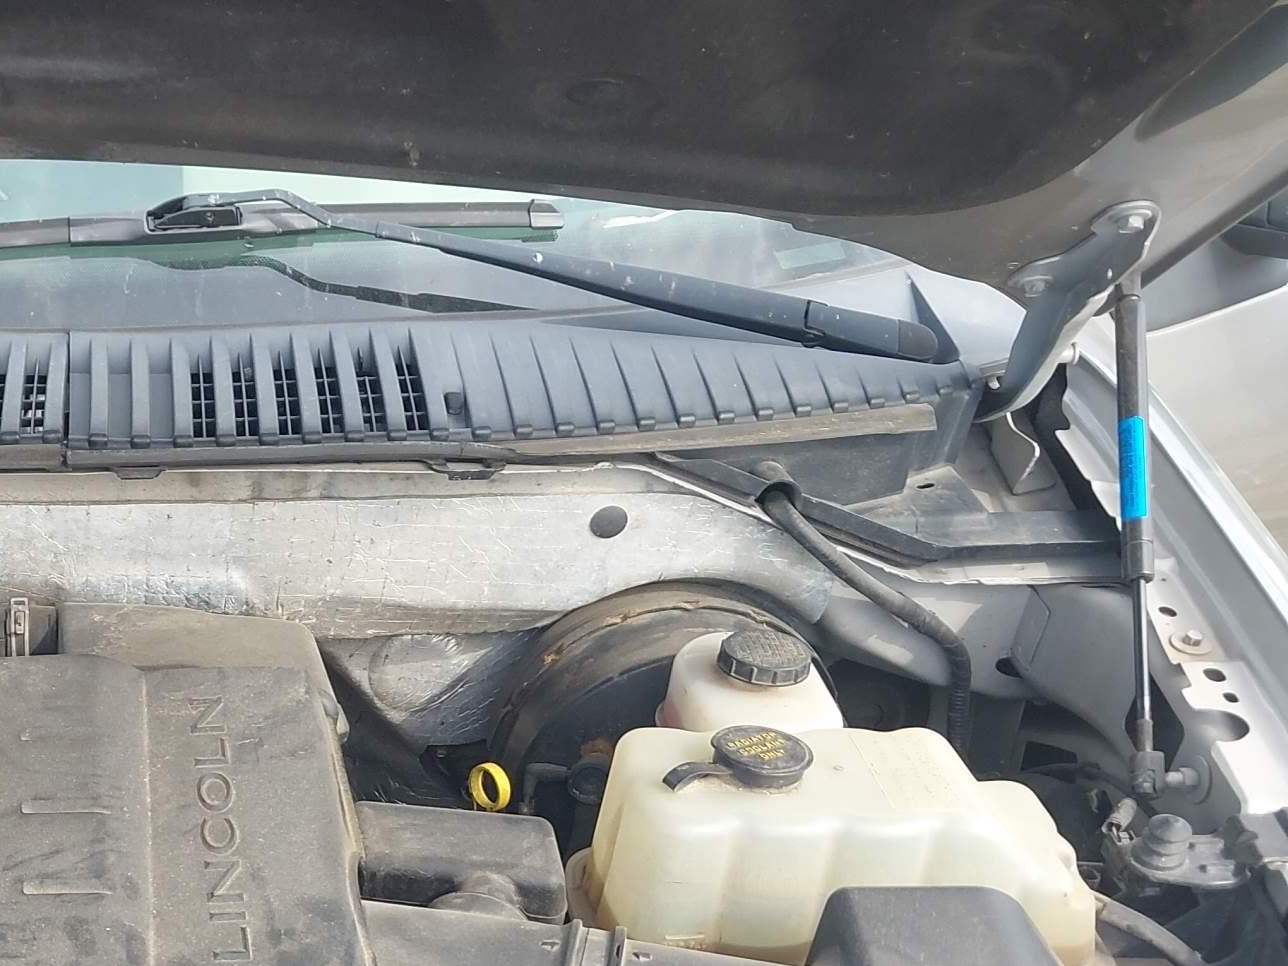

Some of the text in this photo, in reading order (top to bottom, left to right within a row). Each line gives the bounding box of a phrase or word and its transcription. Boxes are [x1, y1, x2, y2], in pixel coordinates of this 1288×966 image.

[727, 731, 777, 749] RADIATOR
[739, 738, 786, 756] COOLANT
[189, 696, 252, 961] LINCOLN
